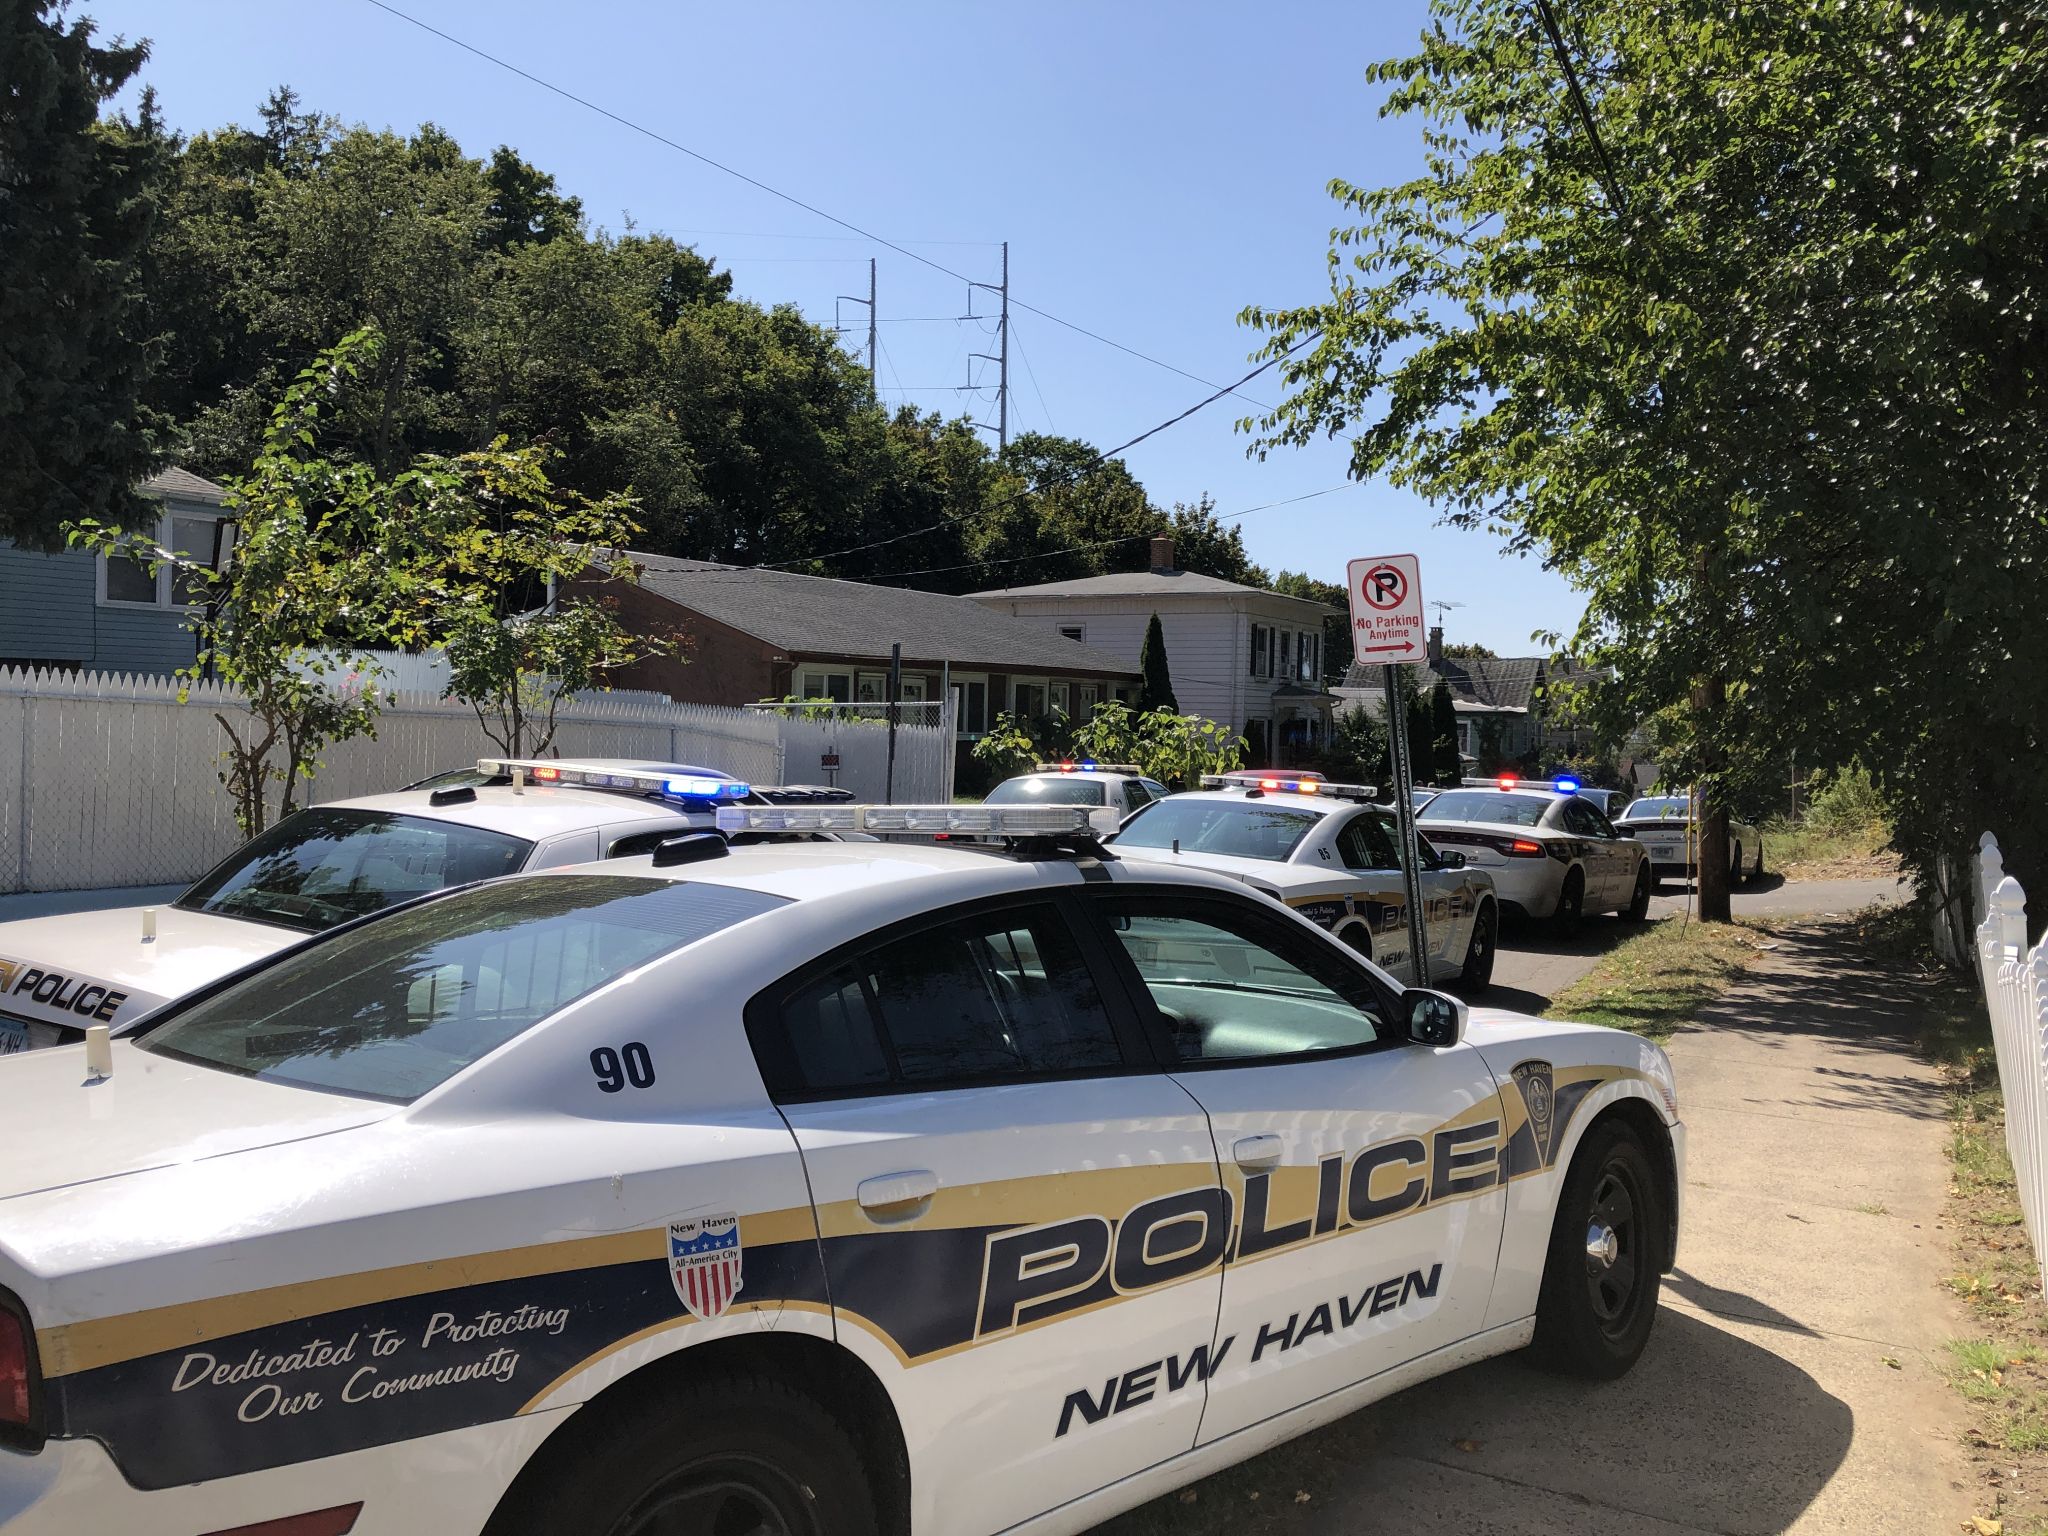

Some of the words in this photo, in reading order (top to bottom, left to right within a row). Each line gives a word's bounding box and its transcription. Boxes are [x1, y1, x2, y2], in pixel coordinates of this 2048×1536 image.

[1356, 617, 1372, 629] No
[1376, 615, 1419, 629] Parking
[1369, 628, 1409, 641] Anytime
[1380, 950, 1405, 967] NEW
[12, 968, 129, 1022] POLICE
[589, 1041, 656, 1093] 90
[1530, 1064, 1553, 1075] HAVEN
[671, 1223, 696, 1234] New
[702, 1217, 736, 1229] Haven
[974, 1118, 1500, 1344] POLICE
[675, 1253, 720, 1268] All-America
[722, 1250, 738, 1260] City
[171, 1332, 356, 1392] Dedicated
[368, 1327, 405, 1357] to
[421, 1304, 571, 1349] Protecting
[1055, 1335, 1236, 1439] NEW
[1250, 1262, 1443, 1363] HAVEN
[236, 1384, 325, 1423] Our
[341, 1347, 520, 1404] Community
